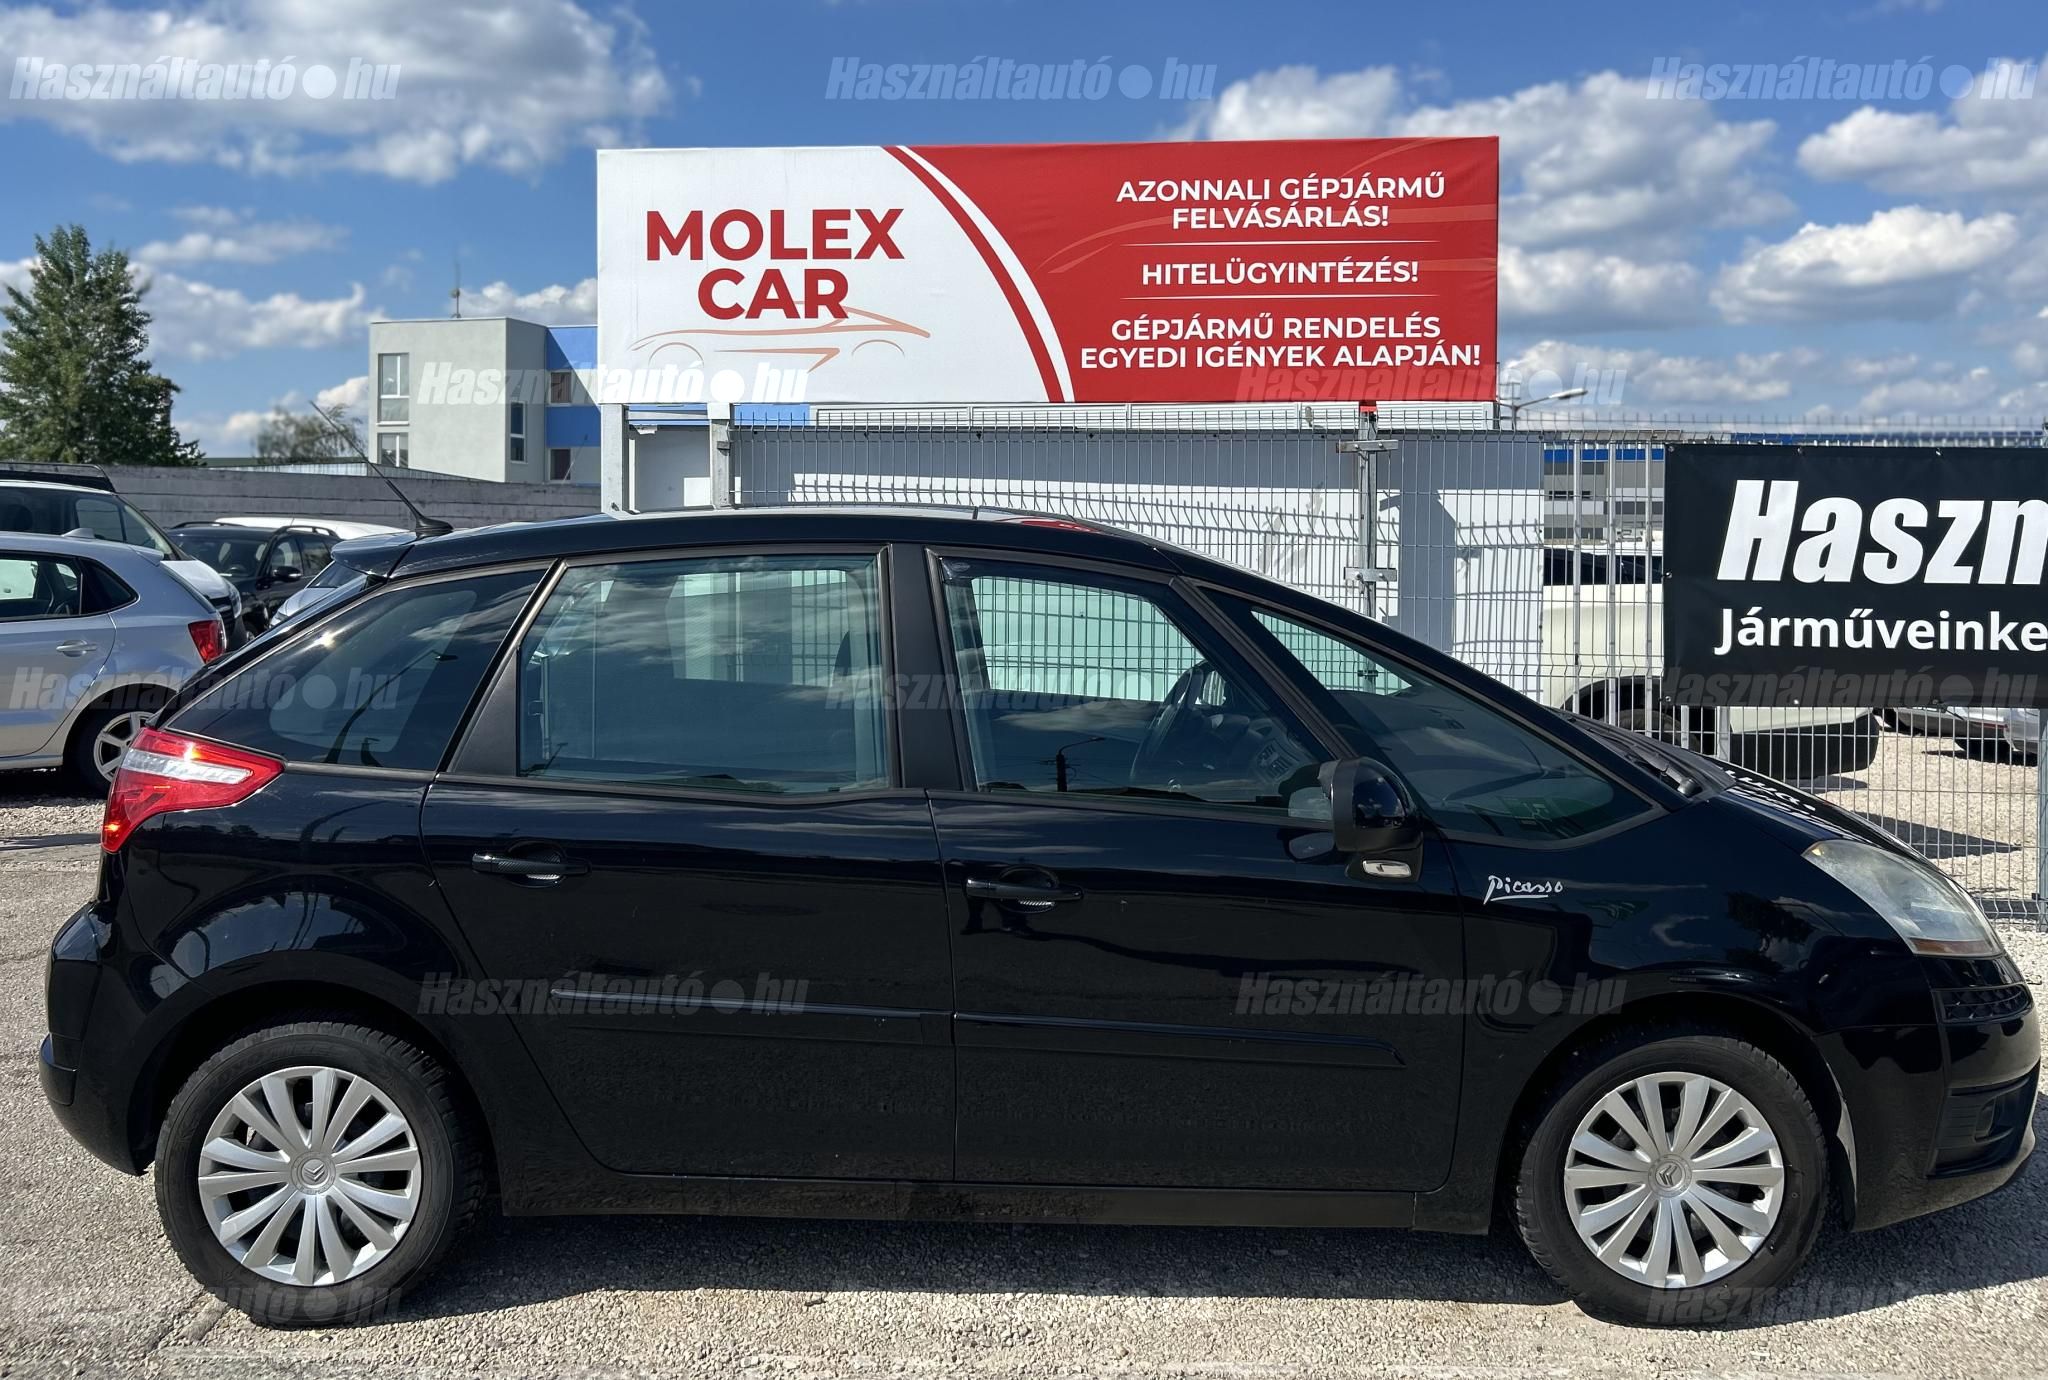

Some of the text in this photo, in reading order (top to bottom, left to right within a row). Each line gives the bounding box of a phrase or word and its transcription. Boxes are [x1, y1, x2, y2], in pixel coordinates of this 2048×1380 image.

[1117, 172, 1444, 204] AZONNALI GÉPJÁRMŰ
[1174, 202, 1388, 229] FELVÁSÁRLÁS!
[647, 209, 905, 261] MOLEX
[1143, 256, 1417, 284] HITELÜGYINTÉZÉS!
[698, 268, 849, 320] CAR
[1112, 312, 1440, 343] GÉPJÁRMŰ RENDELÉS
[1082, 340, 1479, 368] EGYEDI IGÉNYEK ALAPJÁN!
[1483, 875, 1563, 905] Picasso
